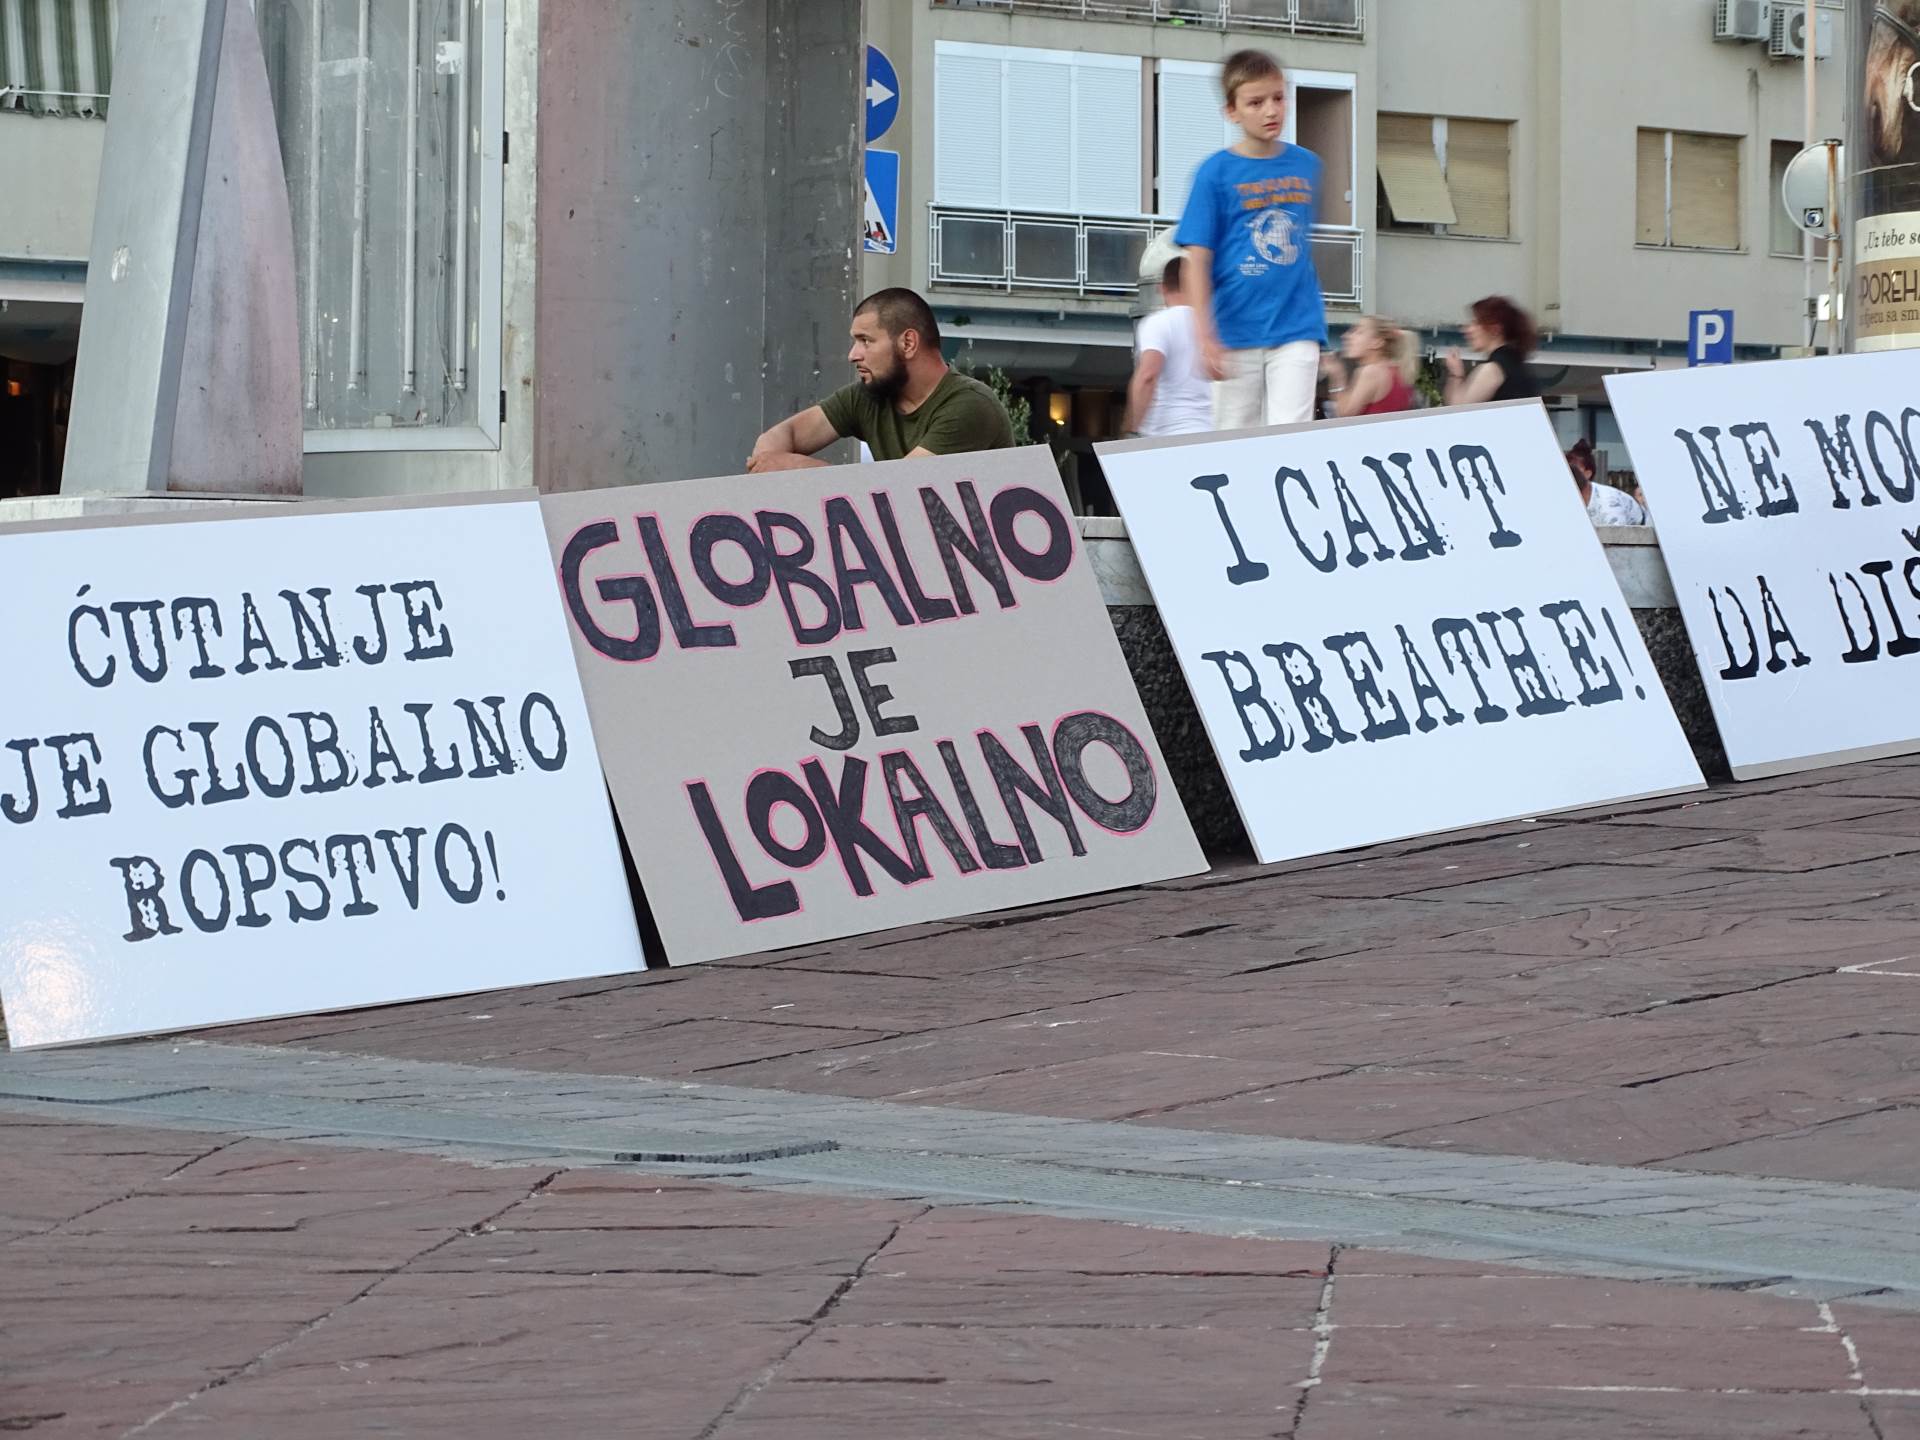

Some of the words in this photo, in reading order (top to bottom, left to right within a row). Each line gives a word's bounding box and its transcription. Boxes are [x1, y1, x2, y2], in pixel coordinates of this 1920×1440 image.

[1859, 269, 1920, 306] POREH
[1881, 228, 1906, 248] tebe
[1697, 314, 1725, 360] P
[1191, 474, 1269, 585] I
[1275, 445, 1523, 573] CAN'T
[1674, 422, 1799, 523] NE
[560, 478, 1076, 664] GLOBALNO
[69, 584, 453, 687] ĆUTANJE
[1709, 576, 1811, 680] DA
[788, 647, 919, 750] JE
[1201, 600, 1647, 763] BREATHE!
[1, 733, 112, 824] JE
[143, 692, 568, 808] GLOBALNO
[684, 708, 1158, 925] LOKALNO
[110, 823, 505, 942] ROPSTVO!
